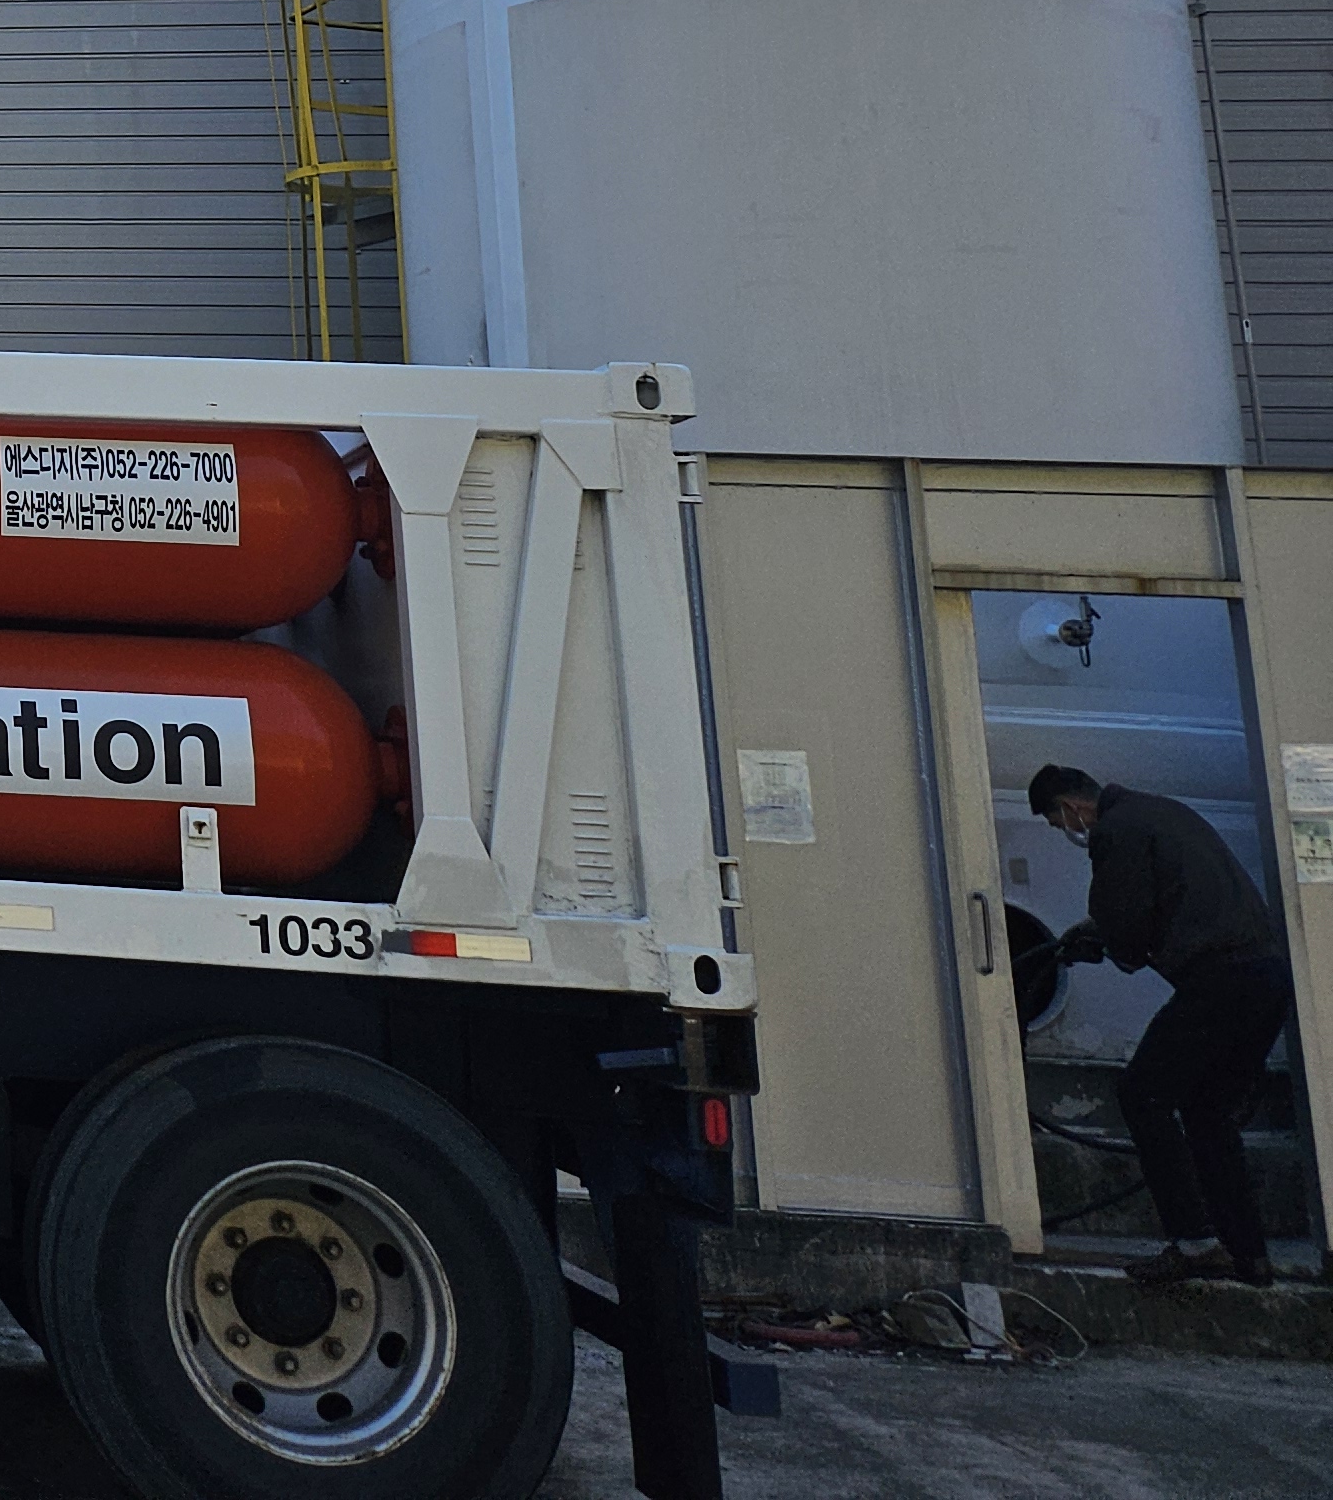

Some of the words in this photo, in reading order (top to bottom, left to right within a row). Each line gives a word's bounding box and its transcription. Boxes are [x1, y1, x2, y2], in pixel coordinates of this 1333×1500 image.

[5, 489, 125, 533] 울산광역시남구청
[128, 496, 237, 534] 052-226-4901
[249, 913, 375, 961] 1033
